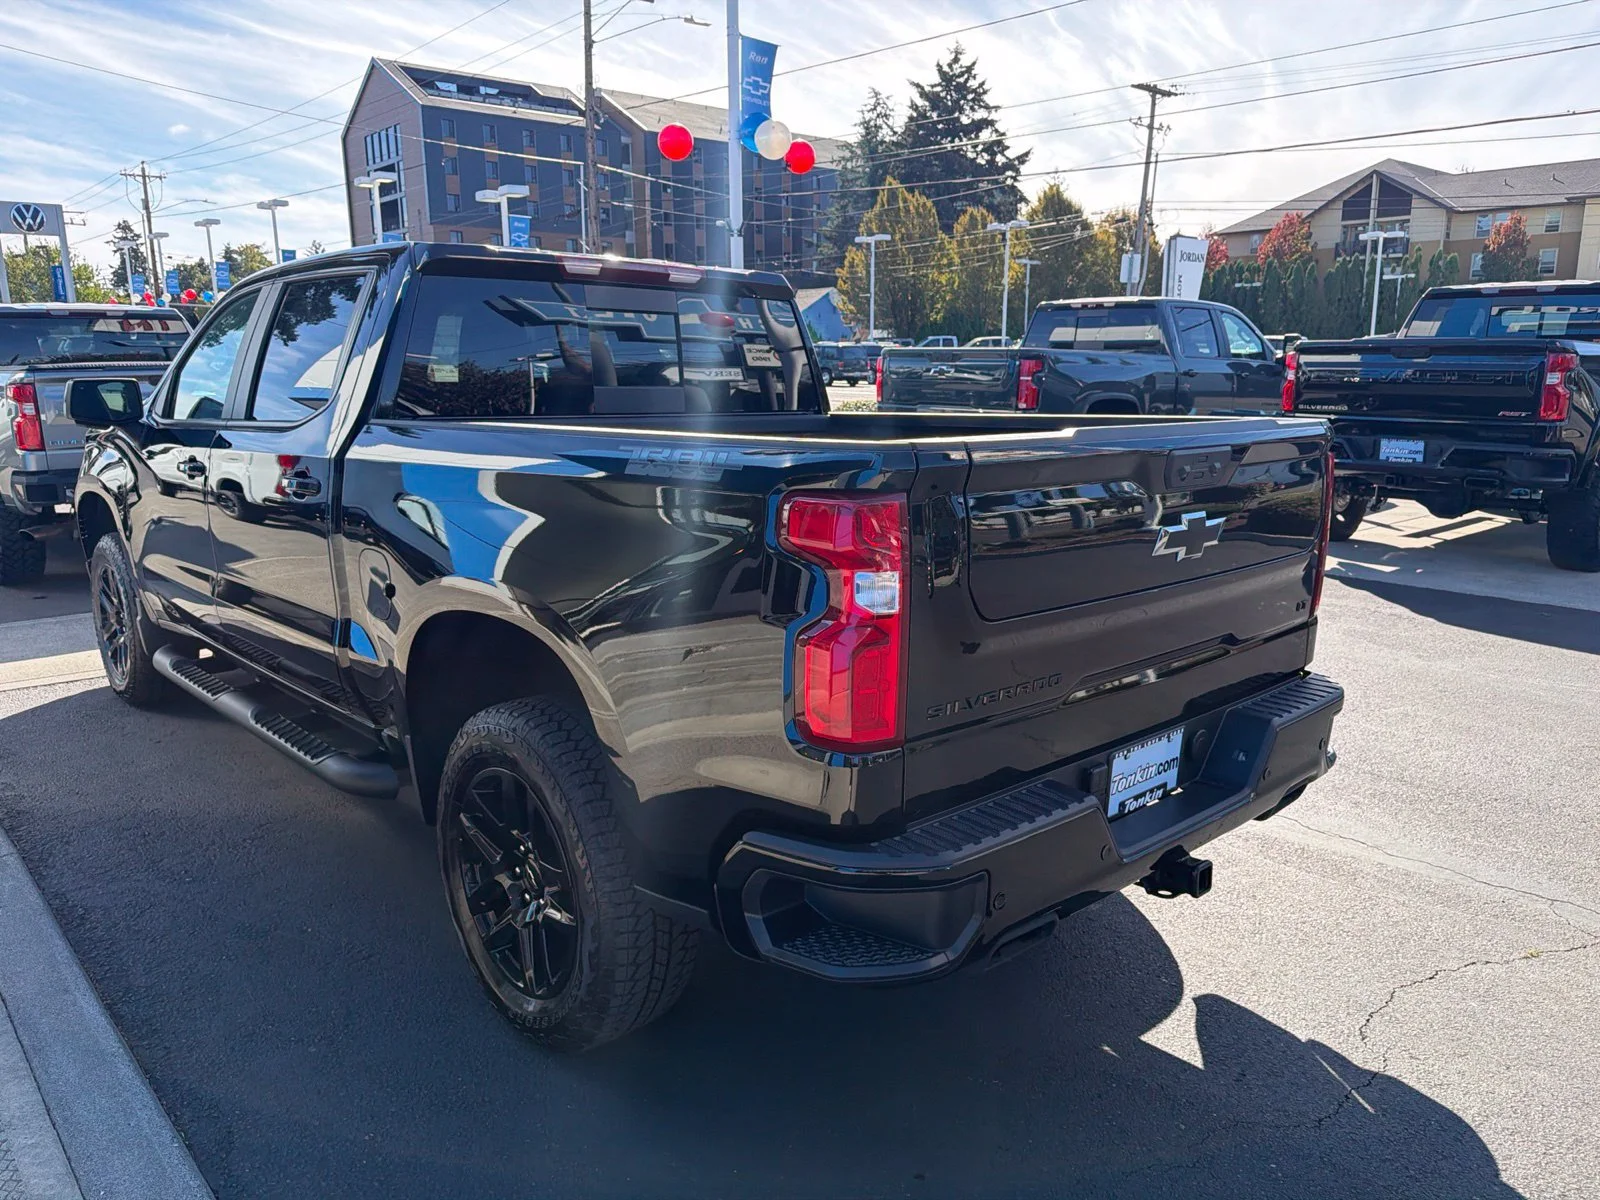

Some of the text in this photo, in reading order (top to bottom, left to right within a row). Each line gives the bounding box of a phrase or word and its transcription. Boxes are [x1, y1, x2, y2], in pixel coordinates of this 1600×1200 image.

[1178, 250, 1205, 263] JORDAN
[926, 672, 1063, 721] SILVERADO
[1110, 757, 1178, 796] Tonkin.com
[1124, 788, 1165, 814] Tonkin
